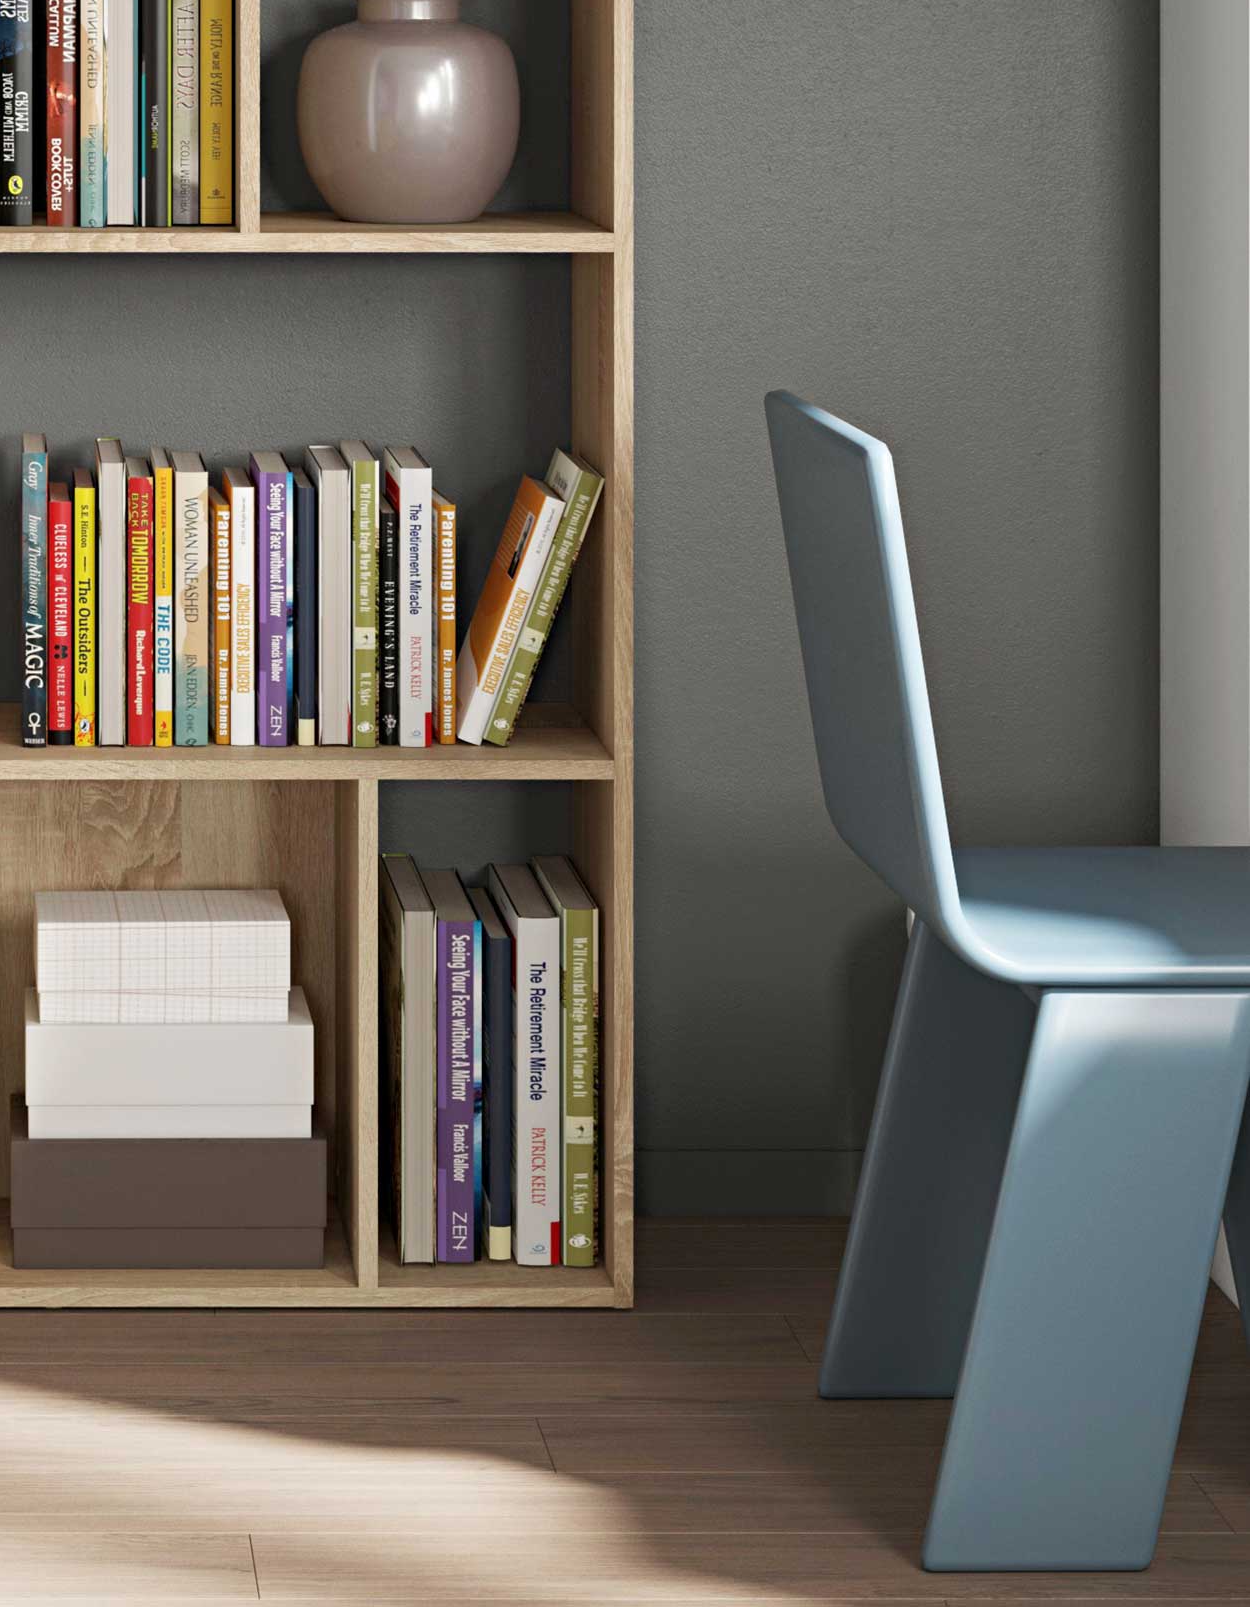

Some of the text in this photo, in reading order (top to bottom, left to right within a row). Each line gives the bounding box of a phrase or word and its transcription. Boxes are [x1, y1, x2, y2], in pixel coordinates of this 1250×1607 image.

[26, 461, 42, 489] Gray
[268, 483, 283, 510] Seeing
[81, 521, 89, 548] Hinton
[270, 512, 283, 530] Your
[271, 532, 283, 549] Face
[55, 524, 67, 568] CLUELESS
[132, 530, 148, 603] TOMORROW
[184, 497, 198, 622] WOMAN UNLEASHED
[270, 551, 283, 582] without
[410, 504, 422, 614] The Retirement Miracle
[441, 511, 454, 620] Parenting 101
[25, 515, 43, 688] Inner Traditions of MAGIC
[55, 587, 67, 636] CLEVELAND
[270, 591, 283, 617] Mirror
[79, 579, 90, 673] The Outsiders
[158, 605, 170, 673] THE CODE
[385, 581, 395, 688] EVENING'S LAND
[134, 630, 145, 715] Richard Levesque
[271, 635, 282, 681] Francis Valloor
[411, 636, 421, 699] PATRICK KELLY
[57, 666, 66, 728] NELLE LEWIS
[444, 649, 452, 735] Dr. James Jones
[270, 705, 282, 736] ZEN
[447, 935, 468, 968] Seeing
[451, 970, 467, 993] Your
[451, 995, 467, 1016] Face
[451, 1018, 468, 1059] without
[529, 962, 545, 1100] The Retirement Miracle
[451, 1069, 468, 1100] Mirror
[453, 1124, 467, 1182] Francis Valloor
[532, 1127, 545, 1205] PATRICK KELLY
[452, 1212, 467, 1250] ZEN
